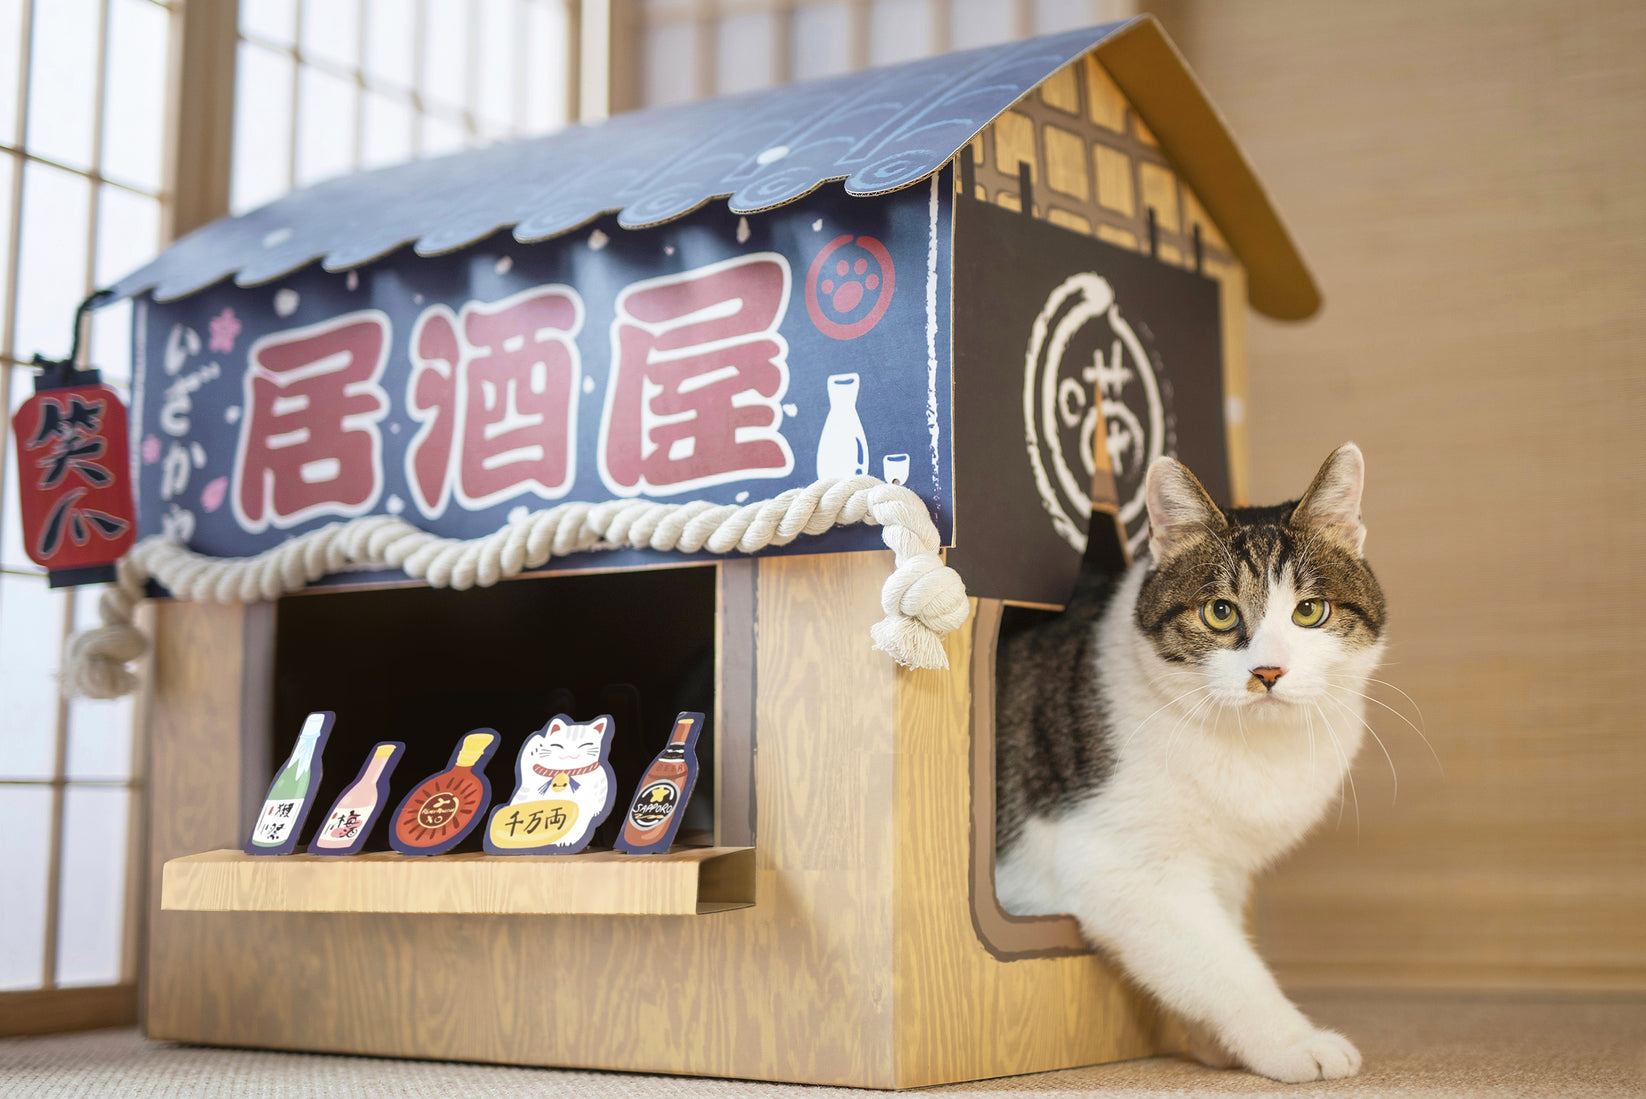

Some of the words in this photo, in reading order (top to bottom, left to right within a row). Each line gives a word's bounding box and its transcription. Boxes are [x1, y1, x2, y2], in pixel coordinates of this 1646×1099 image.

[232, 252, 794, 533] 居酒屋
[633, 802, 673, 814] SAPPORO
[425, 815, 443, 824] XO
[505, 807, 567, 837] 千万両
